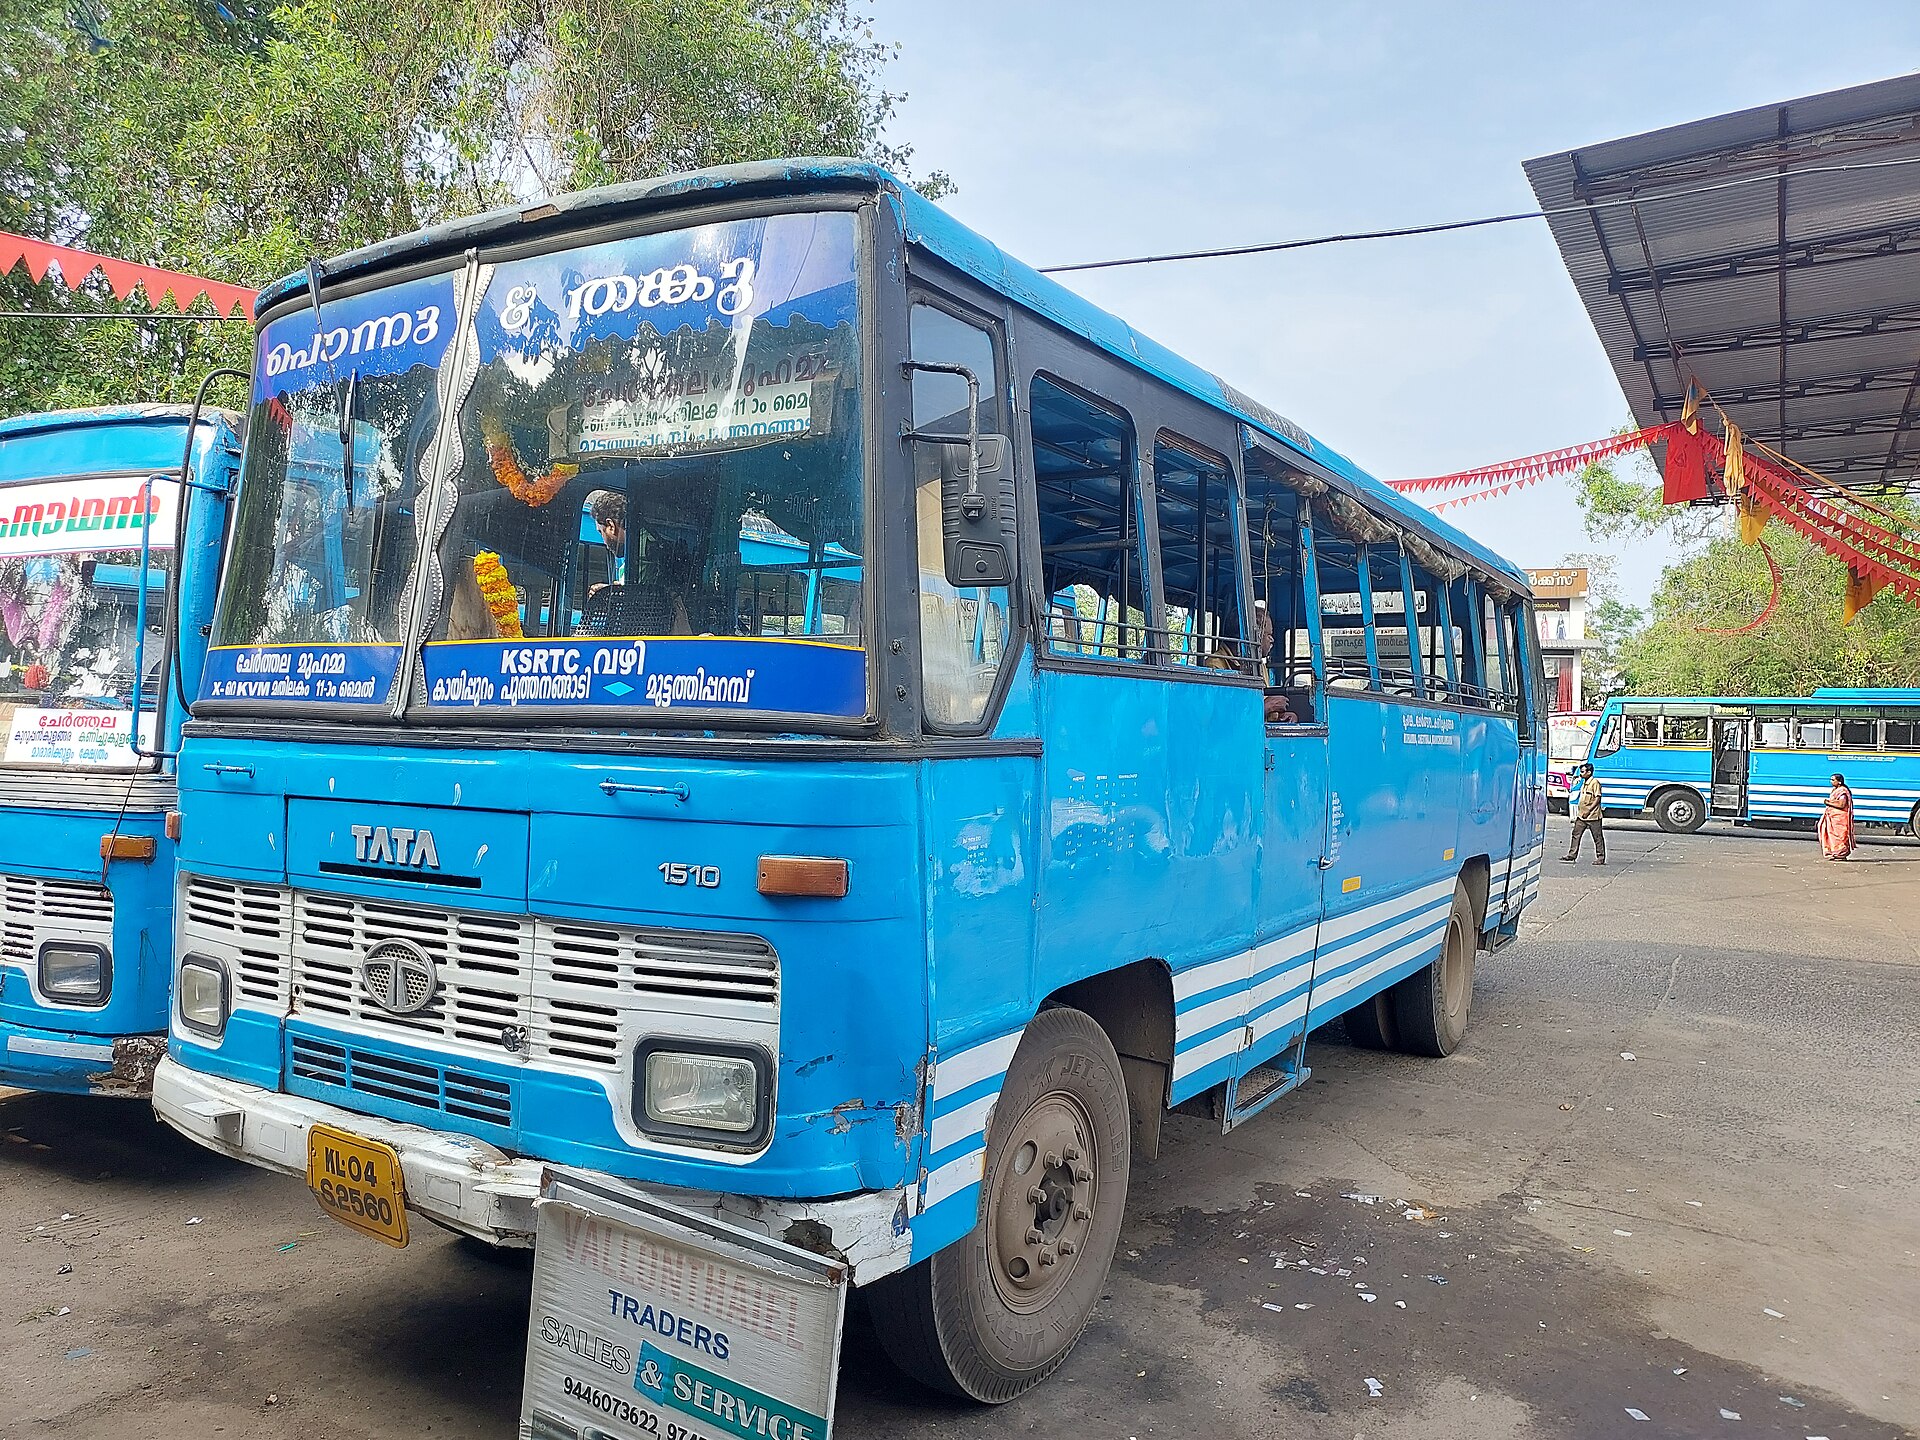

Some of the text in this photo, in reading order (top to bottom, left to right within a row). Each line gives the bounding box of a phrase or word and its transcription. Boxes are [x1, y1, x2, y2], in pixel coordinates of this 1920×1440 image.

[266, 305, 441, 378] പൊന്നു
[500, 286, 537, 330] &
[236, 649, 346, 680] ചേർത്തല മുഹമ്മ
[501, 640, 646, 675] KSRTC വഴി
[236, 681, 271, 697] KVM
[351, 824, 440, 867] TATA
[658, 862, 721, 888] 1510
[320, 1178, 393, 1226] S2560
[608, 1289, 730, 1360] TRADERS
[542, 1315, 631, 1375] SALES
[640, 1358, 664, 1391] &
